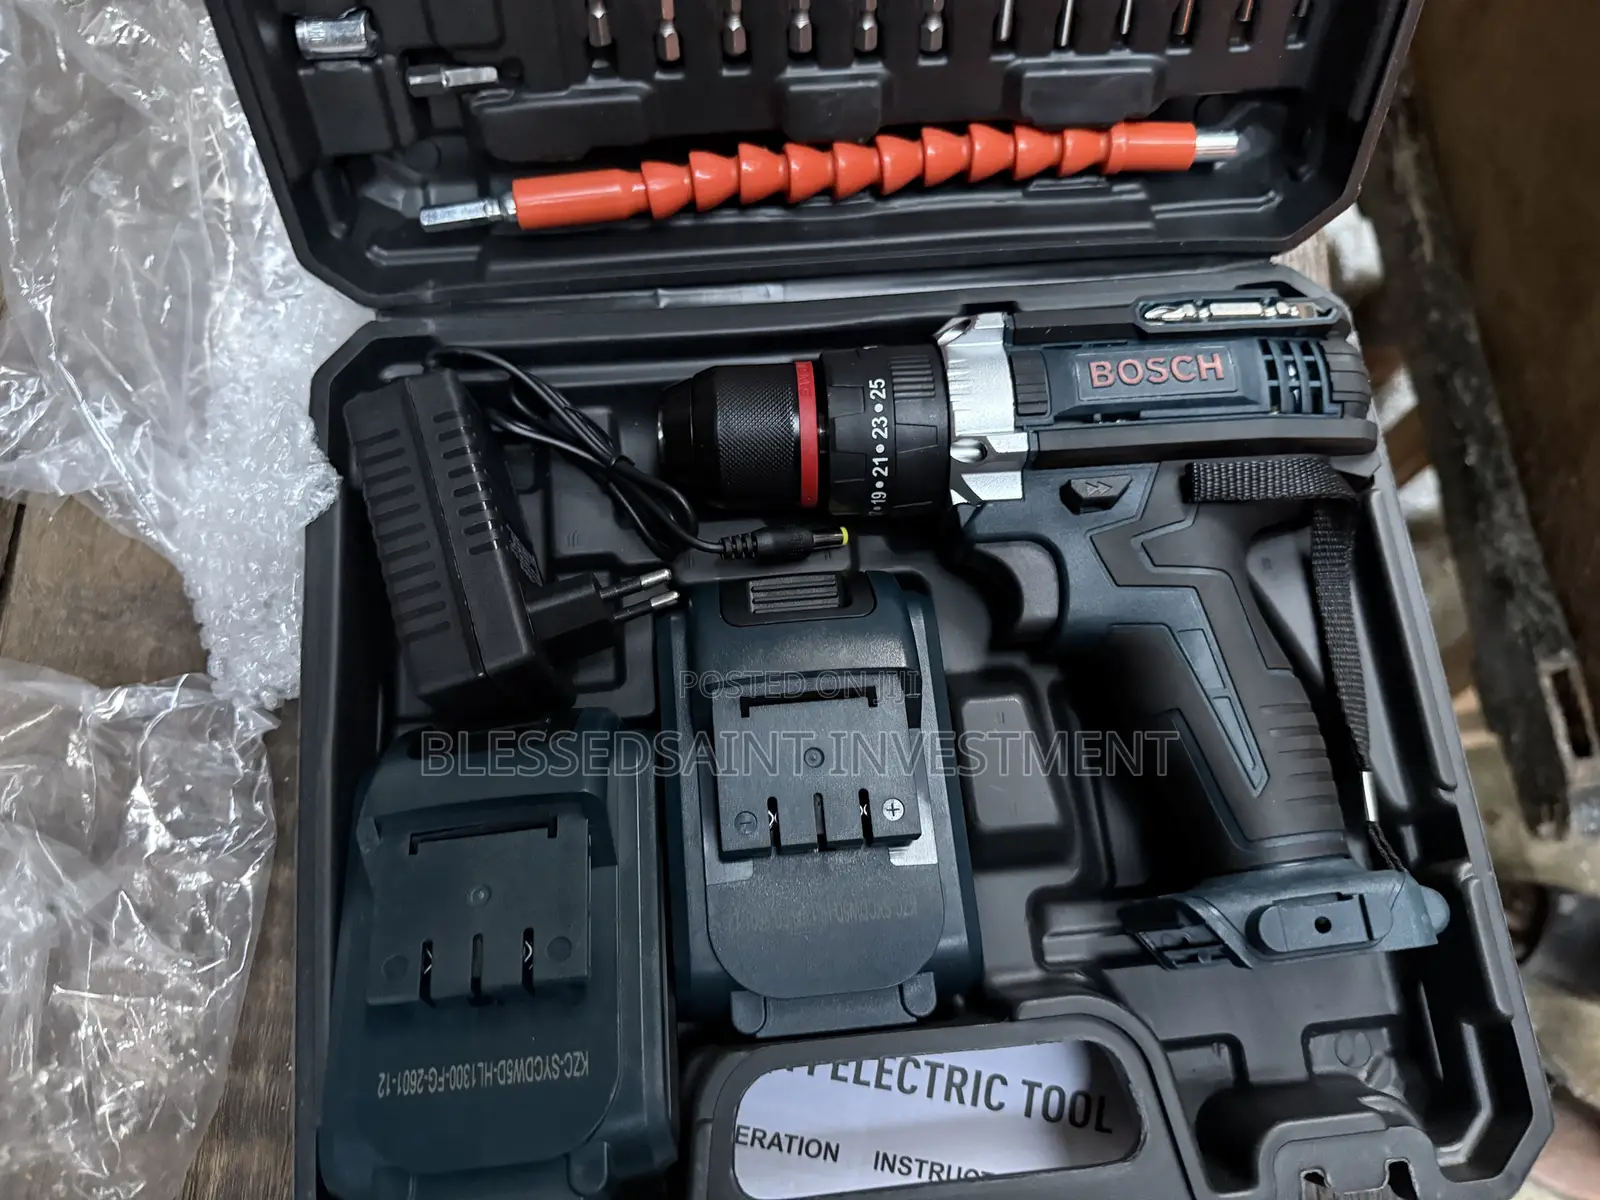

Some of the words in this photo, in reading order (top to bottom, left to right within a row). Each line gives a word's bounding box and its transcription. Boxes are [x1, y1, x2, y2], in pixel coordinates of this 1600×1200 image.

[1088, 353, 1225, 389] BOSCH
[868, 378, 886, 400] 25
[871, 416, 888, 439] 23
[871, 457, 889, 477] 21
[830, 1056, 1009, 1111] ELECTRIC
[1021, 1078, 1114, 1135] TOOL
[873, 1150, 995, 1181] INSTRU
